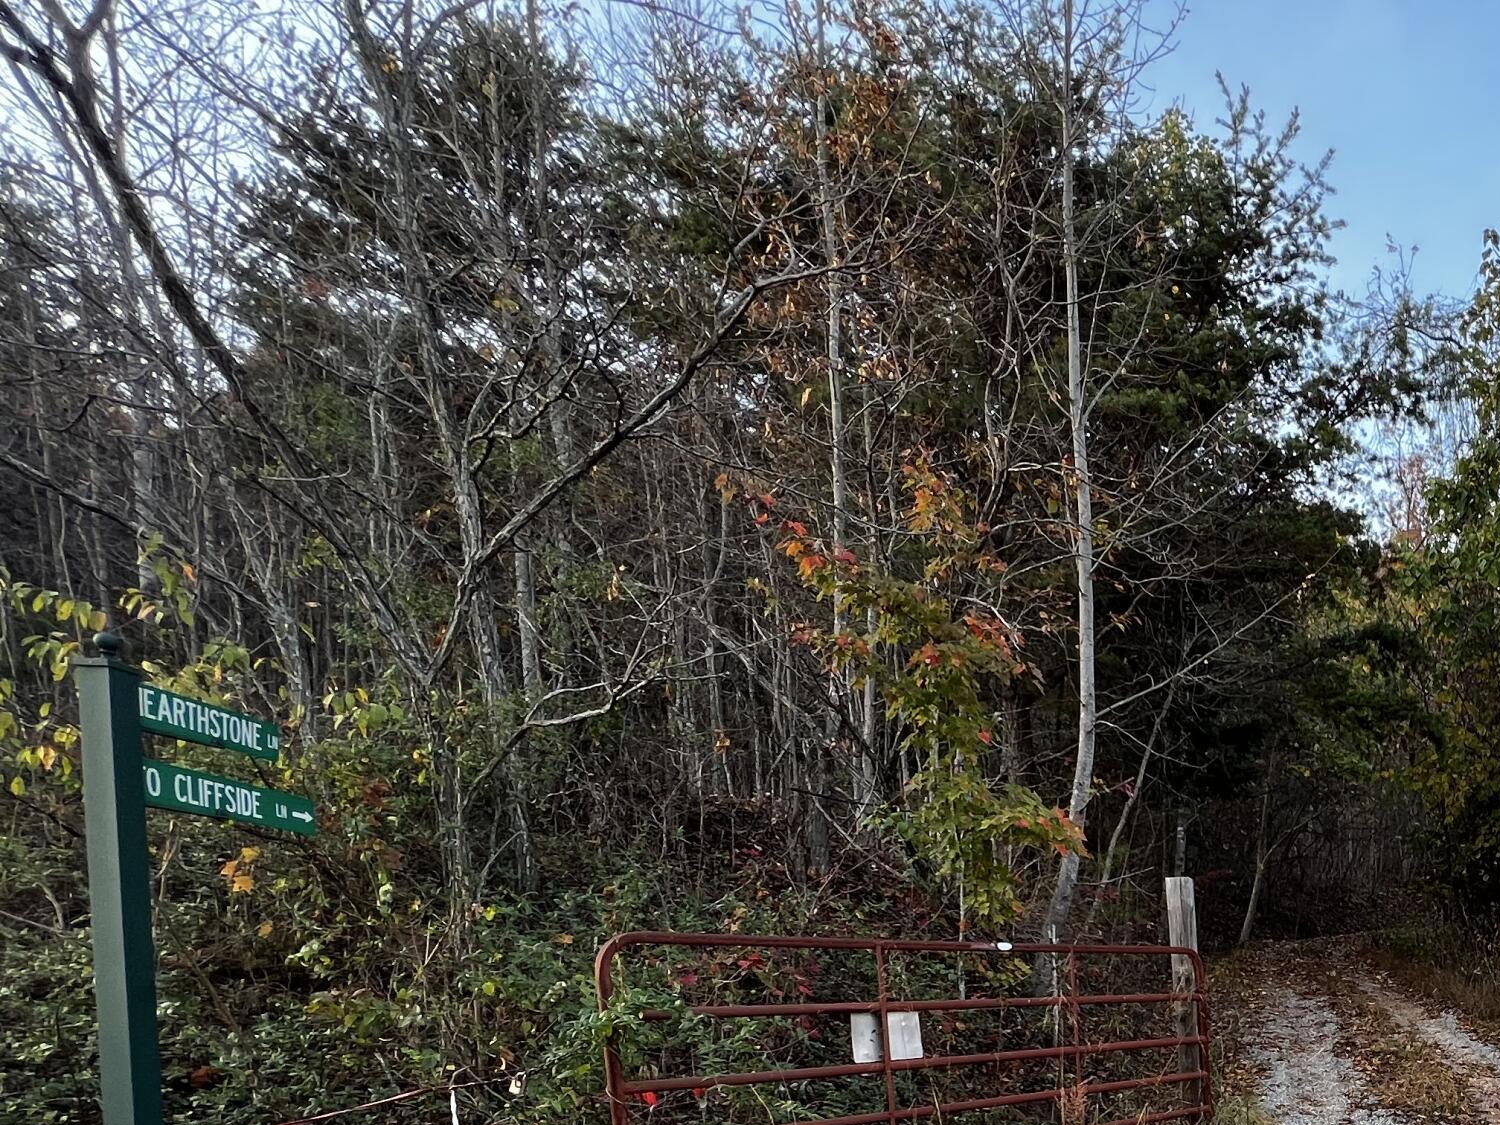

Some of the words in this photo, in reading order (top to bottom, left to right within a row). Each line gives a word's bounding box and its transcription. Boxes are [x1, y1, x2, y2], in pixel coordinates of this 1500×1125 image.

[267, 734, 279, 750] LN
[143, 766, 161, 797] O
[174, 773, 263, 819] CLIFFSIDE
[275, 803, 288, 819] LN
